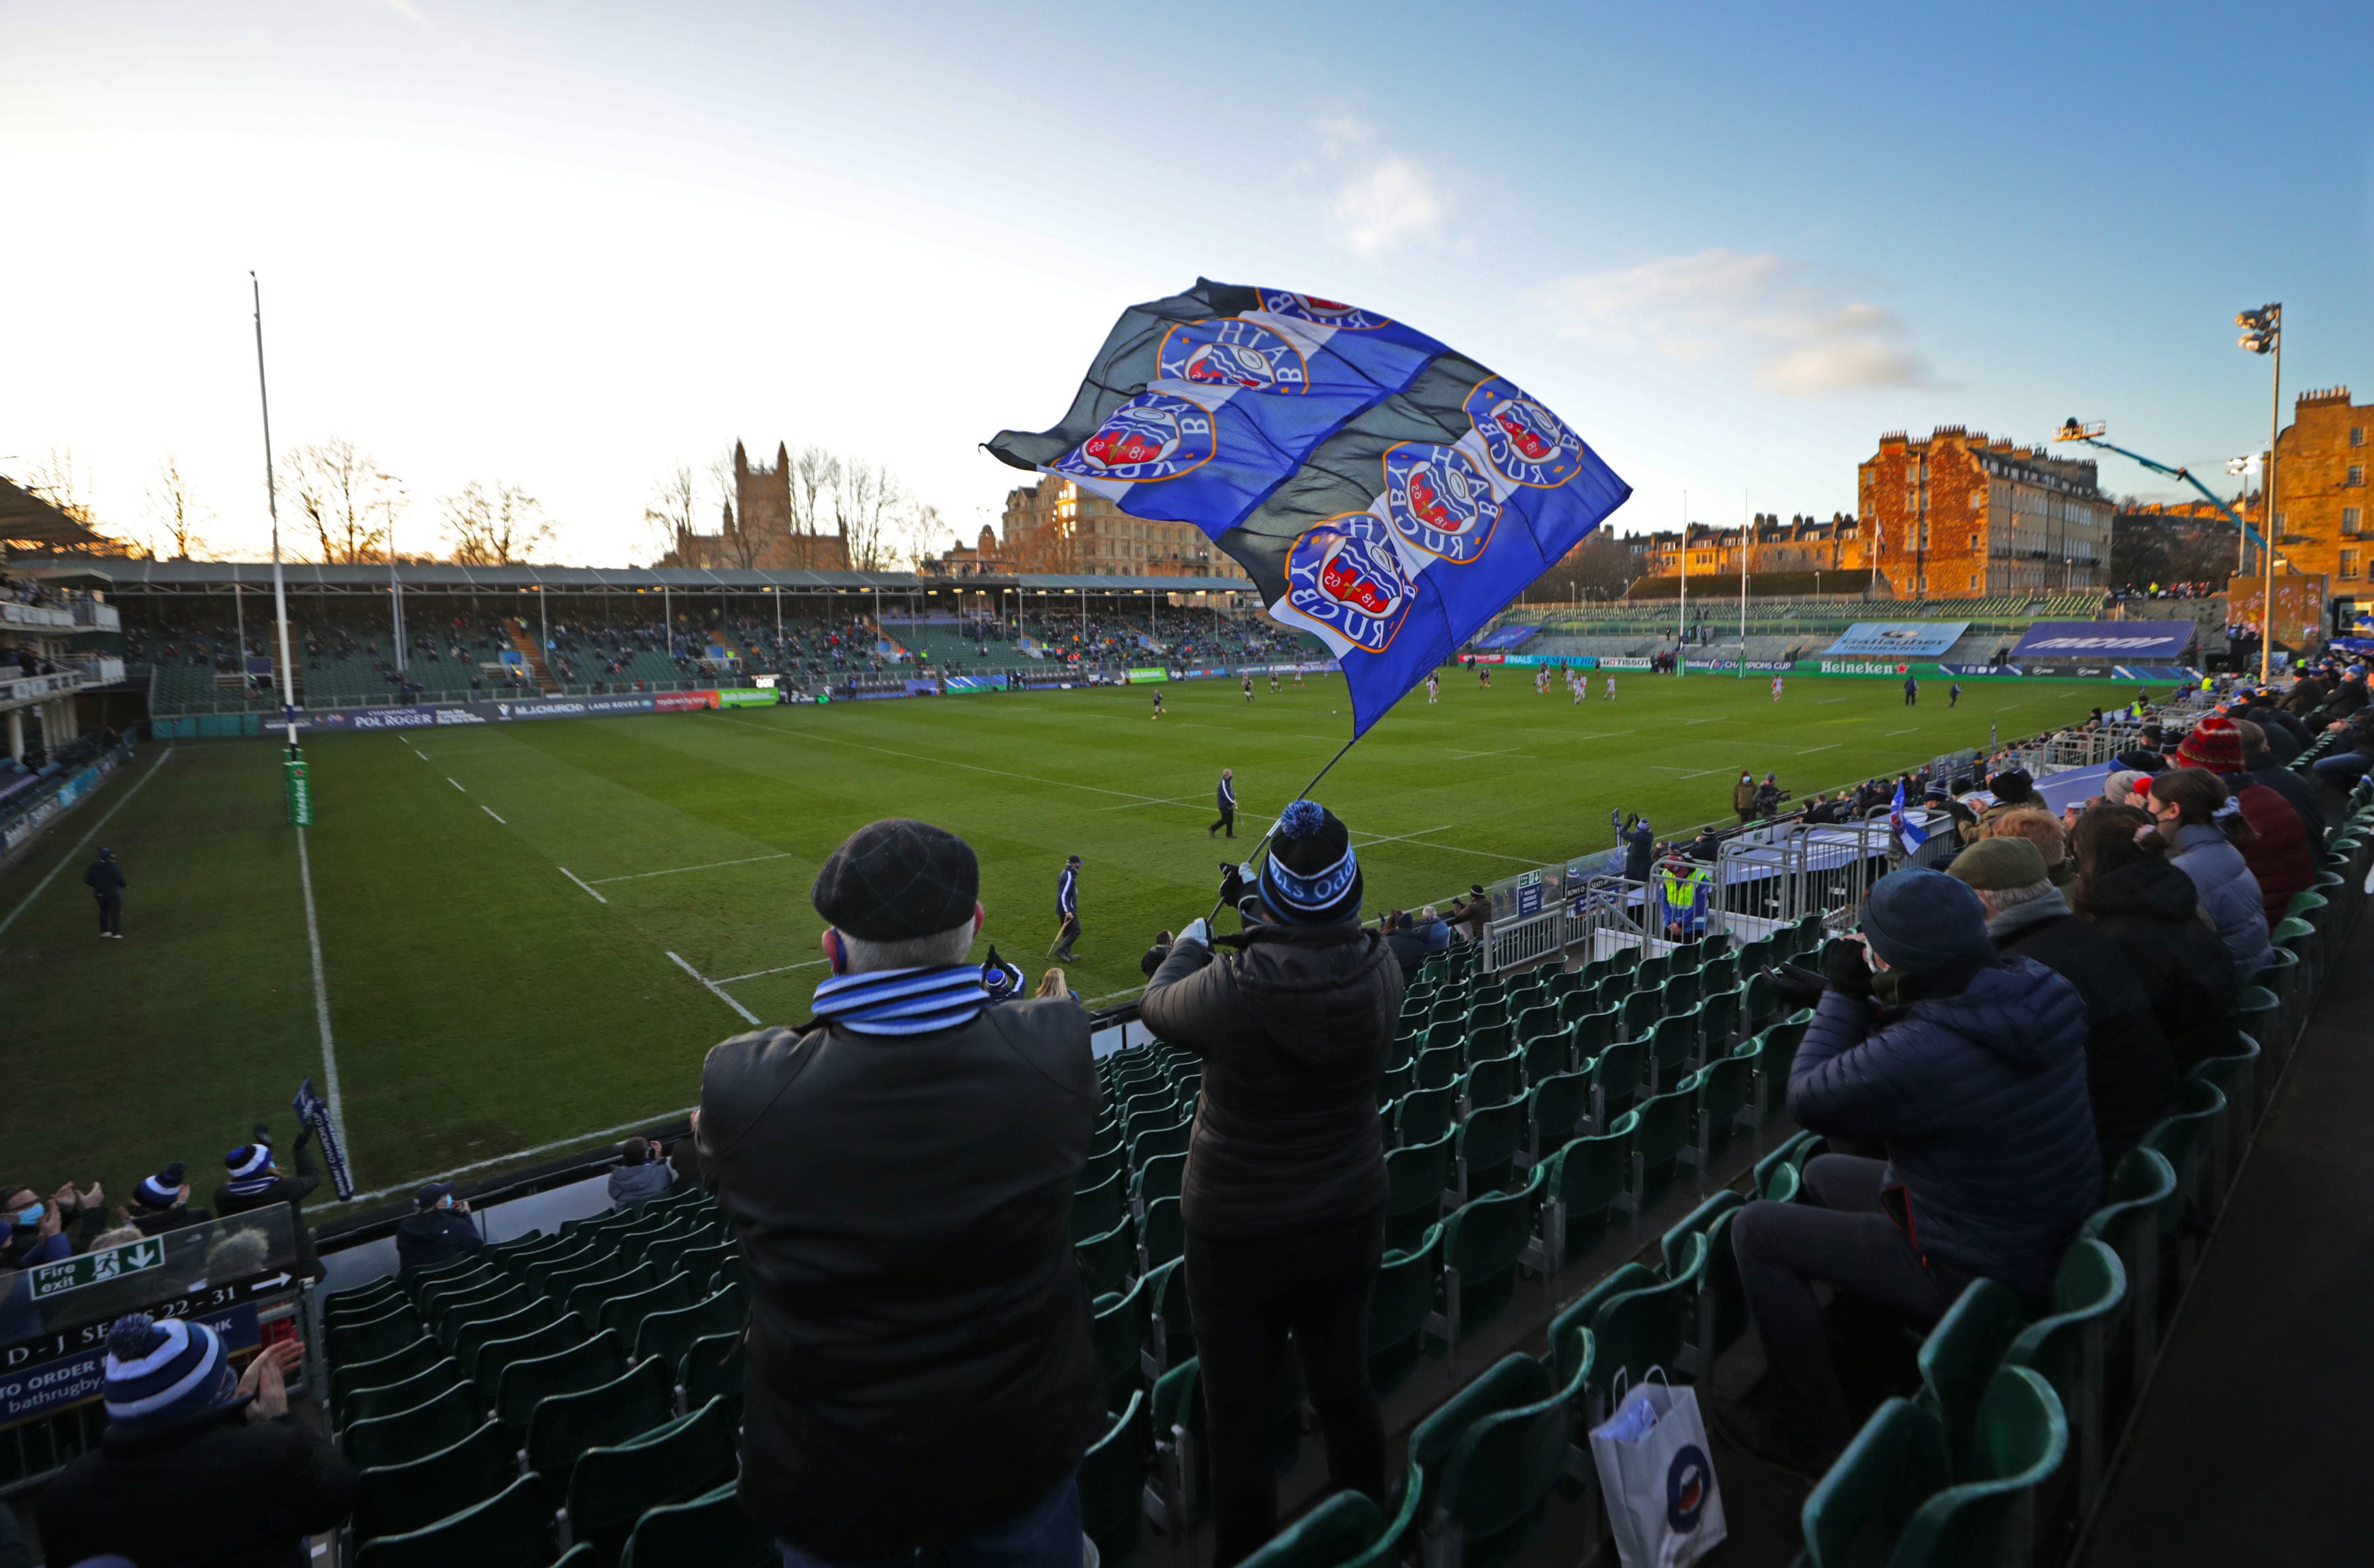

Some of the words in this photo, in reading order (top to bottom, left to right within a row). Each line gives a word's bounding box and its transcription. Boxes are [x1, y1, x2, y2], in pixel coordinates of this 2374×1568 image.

[1842, 638, 1947, 646] Gallagher
[1505, 656, 1531, 664] FINALS
[1581, 656, 1596, 665] 202
[1774, 661, 1791, 670] CUP
[1821, 661, 1894, 674] Heineken
[721, 692, 737, 701] Bath
[587, 703, 611, 711] LAND
[612, 701, 640, 709] ROVER
[354, 716, 379, 728] POL
[385, 713, 433, 726] ROGER
[1567, 888, 1581, 897] ROWS
[39, 1263, 75, 1281] Fire
[41, 1276, 75, 1293] exit
[7, 1347, 29, 1366] D
[57, 1335, 64, 1355] J
[81, 1309, 155, 1343] SES
[162, 1299, 189, 1318] 22
[212, 1286, 235, 1306] 31
[0, 1383, 22, 1400] TO
[28, 1360, 96, 1389] ORDER
